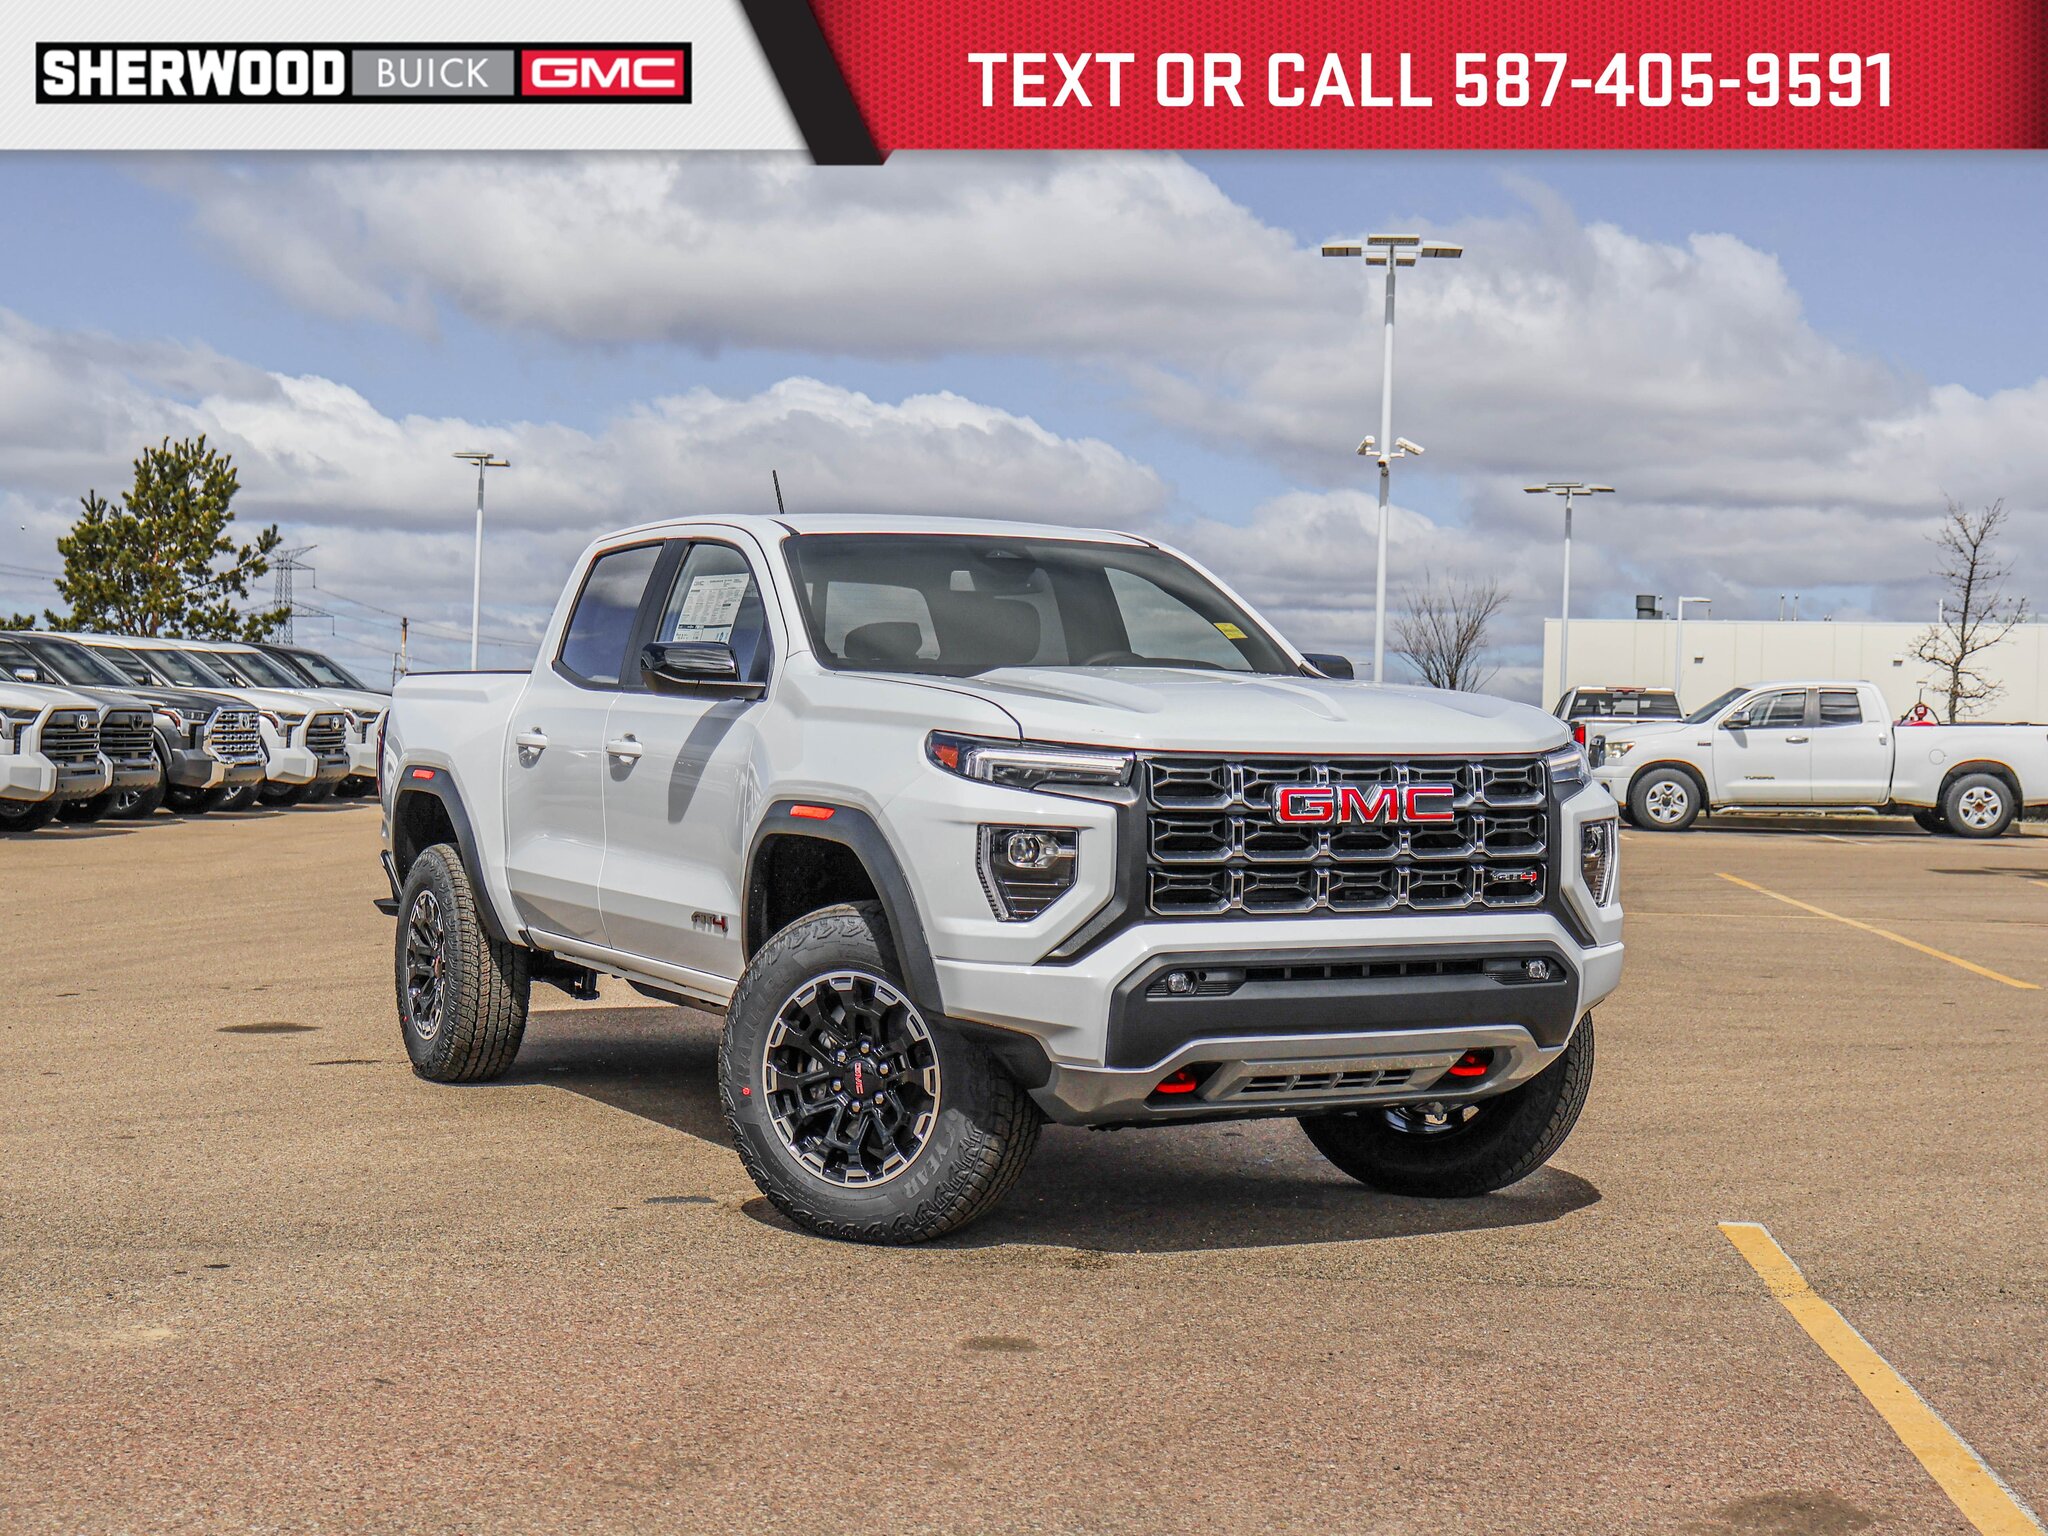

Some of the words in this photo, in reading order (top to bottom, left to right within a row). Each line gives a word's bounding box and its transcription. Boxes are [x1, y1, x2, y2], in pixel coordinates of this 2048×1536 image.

[1275, 784, 1455, 825] GMC
[1491, 870, 1537, 884] AT4
[854, 1062, 864, 1095] GMC
